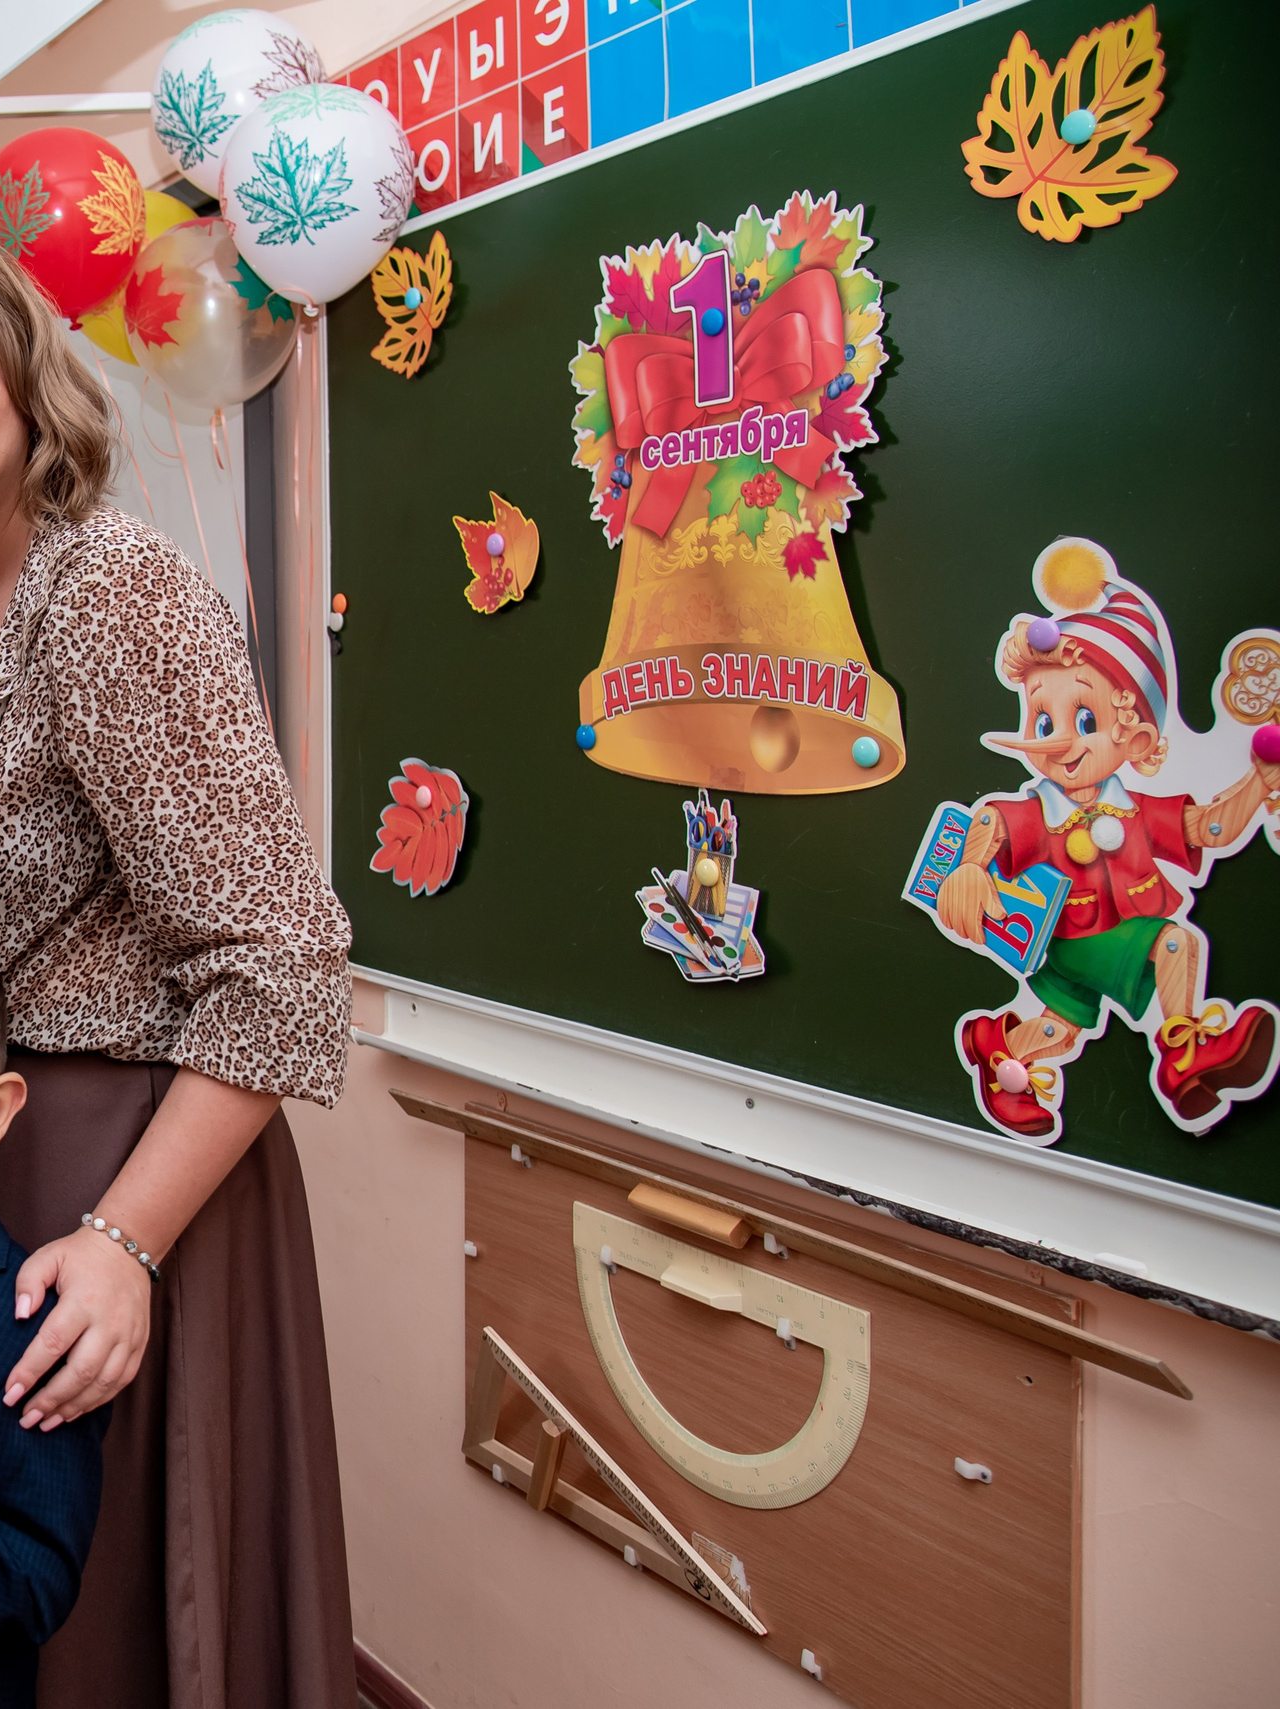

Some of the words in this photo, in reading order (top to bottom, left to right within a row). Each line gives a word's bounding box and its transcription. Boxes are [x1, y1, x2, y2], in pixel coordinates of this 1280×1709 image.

[412, 47, 442, 104] У
[469, 15, 505, 82] Ы
[533, 0, 570, 47] Э
[472, 111, 504, 174] И
[543, 84, 566, 147] Е
[671, 251, 733, 406] 1
[641, 407, 807, 469] сентября
[603, 657, 694, 719] ДЕНЬ
[702, 653, 870, 720] ЗНАНИЙ
[914, 815, 966, 900] АЗБУКА
